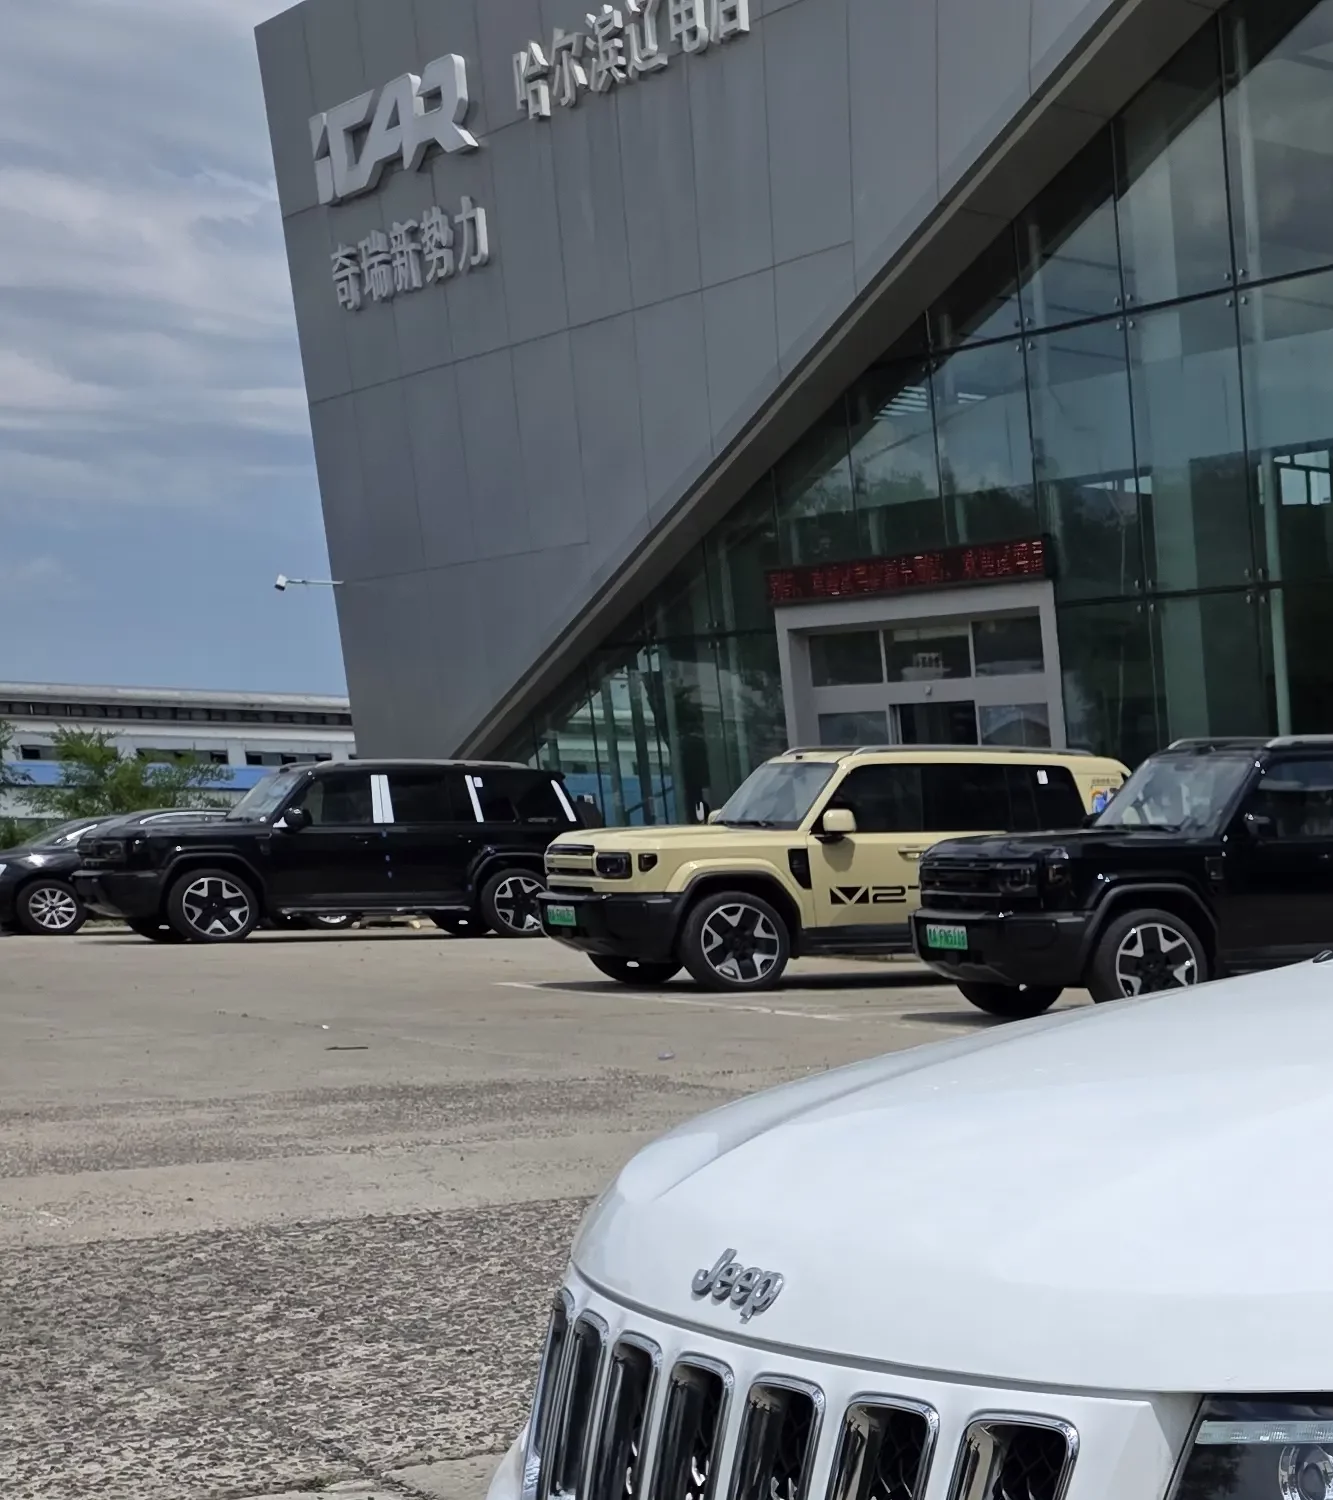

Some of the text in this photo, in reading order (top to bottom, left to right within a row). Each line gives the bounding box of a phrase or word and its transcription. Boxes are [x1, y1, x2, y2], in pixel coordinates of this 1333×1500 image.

[331, 196, 490, 312] 奇瑞新势力
[829, 885, 919, 905] V2
[691, 1248, 784, 1321] Jeep
